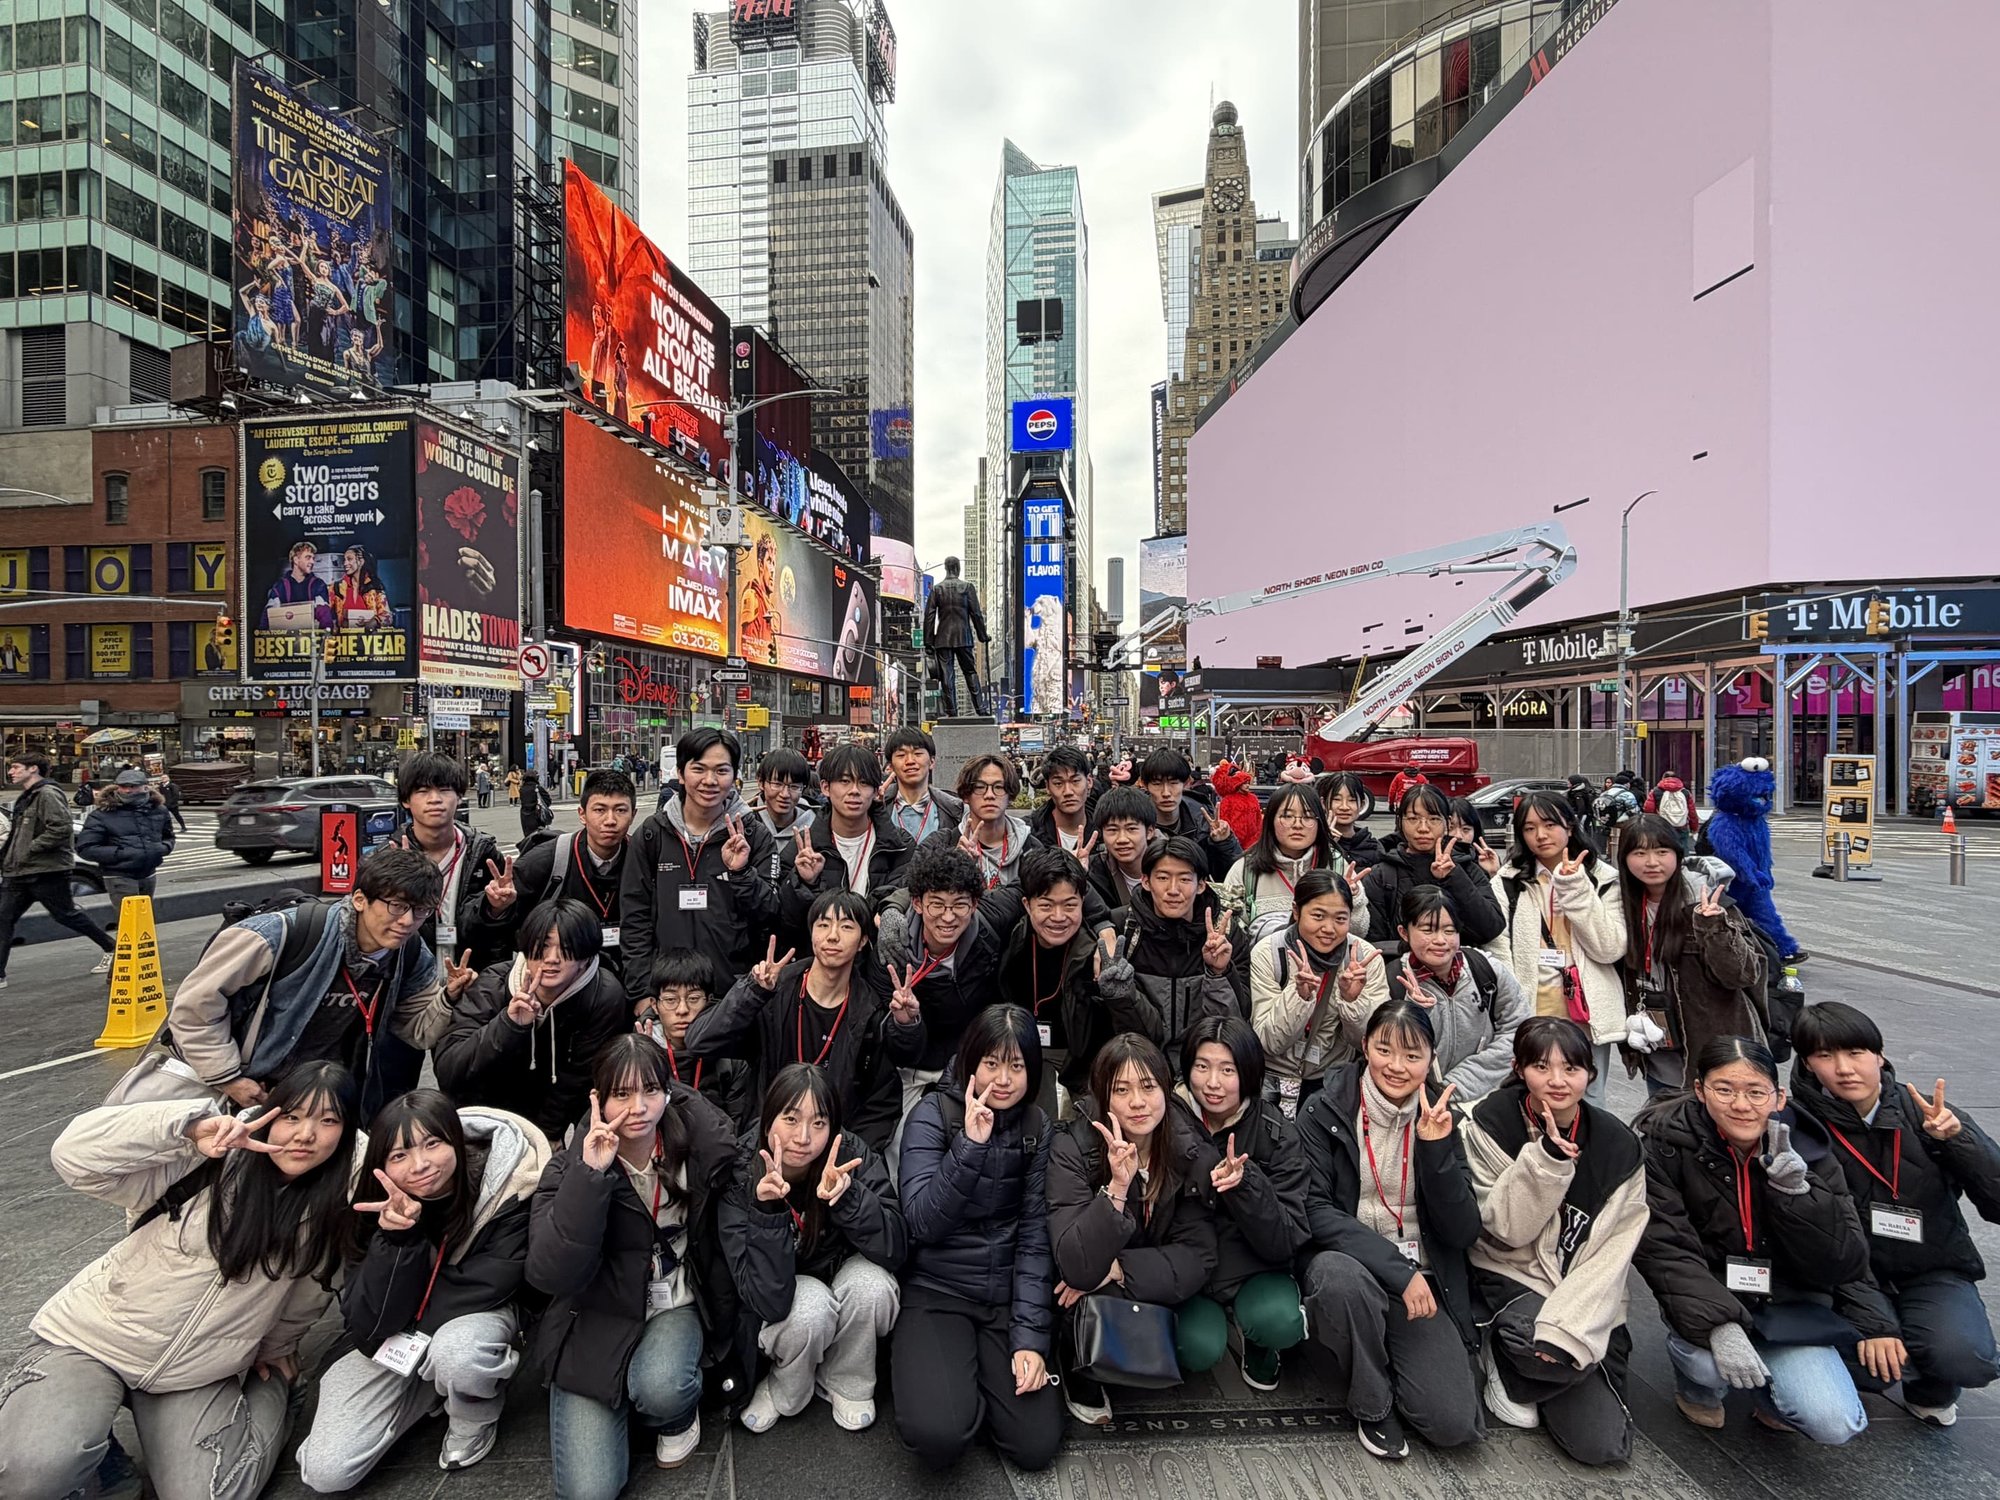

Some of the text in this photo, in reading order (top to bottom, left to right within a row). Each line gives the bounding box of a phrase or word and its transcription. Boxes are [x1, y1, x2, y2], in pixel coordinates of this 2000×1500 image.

[1556, 0, 1613, 61] MARQUIS
[251, 100, 270, 116] THAT
[271, 111, 307, 135] EXPLODES
[308, 131, 324, 147] WITH
[278, 104, 359, 157] EXTRAVAGANZA
[304, 108, 323, 125] BIG
[326, 121, 380, 157] BROADWAY
[251, 116, 378, 206] THE GREAT
[268, 157, 365, 220] GATSBY
[294, 195, 314, 209] NEW
[315, 205, 350, 228] MUSICAL
[652, 270, 714, 334] LIVE ON BROADWAY
[650, 291, 715, 369] NOW SEE
[657, 326, 710, 389] HOW IT
[736, 360, 750, 369] LG
[312, 363, 350, 381] BROADWAY
[642, 347, 721, 424] ALL BEGAN
[265, 420, 408, 438] EFFERVESCENT NEW MUSICAL COMEDY!
[1028, 421, 1056, 429] PEPSI
[264, 435, 307, 449] LAUGHTER,
[309, 435, 341, 446] ESCAPE,
[438, 430, 503, 470] COME SEE HOW THE
[292, 462, 329, 485] two
[424, 440, 515, 494] WORLD COULD BE
[655, 465, 684, 486] RYAN
[285, 480, 380, 507] strangers
[283, 505, 306, 517] carry
[314, 503, 335, 514] cake
[303, 510, 375, 525] across new york
[679, 500, 709, 521] PROJEC
[1027, 505, 1060, 513] TO GET
[662, 534, 726, 578] MARY
[95, 556, 125, 591] O
[196, 554, 225, 588] Y
[1027, 565, 1060, 576] FLAVOR
[1263, 560, 1384, 596] NORTH SHORE NEON SIGN CO
[677, 576, 718, 597] FILMED FOR
[668, 583, 722, 623] IMAX
[1828, 595, 1962, 630] Mbile
[422, 603, 518, 648] HADESTOWN
[254, 636, 296, 657] BEST
[362, 635, 406, 656] YEAR
[672, 630, 720, 652] 03.20.26
[1522, 633, 1597, 665] T Mobile
[1362, 695, 1387, 718] NORTH
[1388, 677, 1413, 699] SHORE
[1413, 662, 1435, 681] NEON
[1435, 648, 1453, 666] SIGN
[1453, 640, 1465, 653] CO
[208, 684, 370, 700] GIFTS LUGGAGE
[419, 684, 512, 701] GIFTS LUGGAGE
[332, 864, 348, 876] MJ
[138, 971, 157, 980] FLOOR
[141, 963, 154, 971] WET
[137, 993, 162, 1003] MOJADO
[142, 985, 155, 994] PISO
[1102, 1414, 1341, 1433] 52ND STREET
